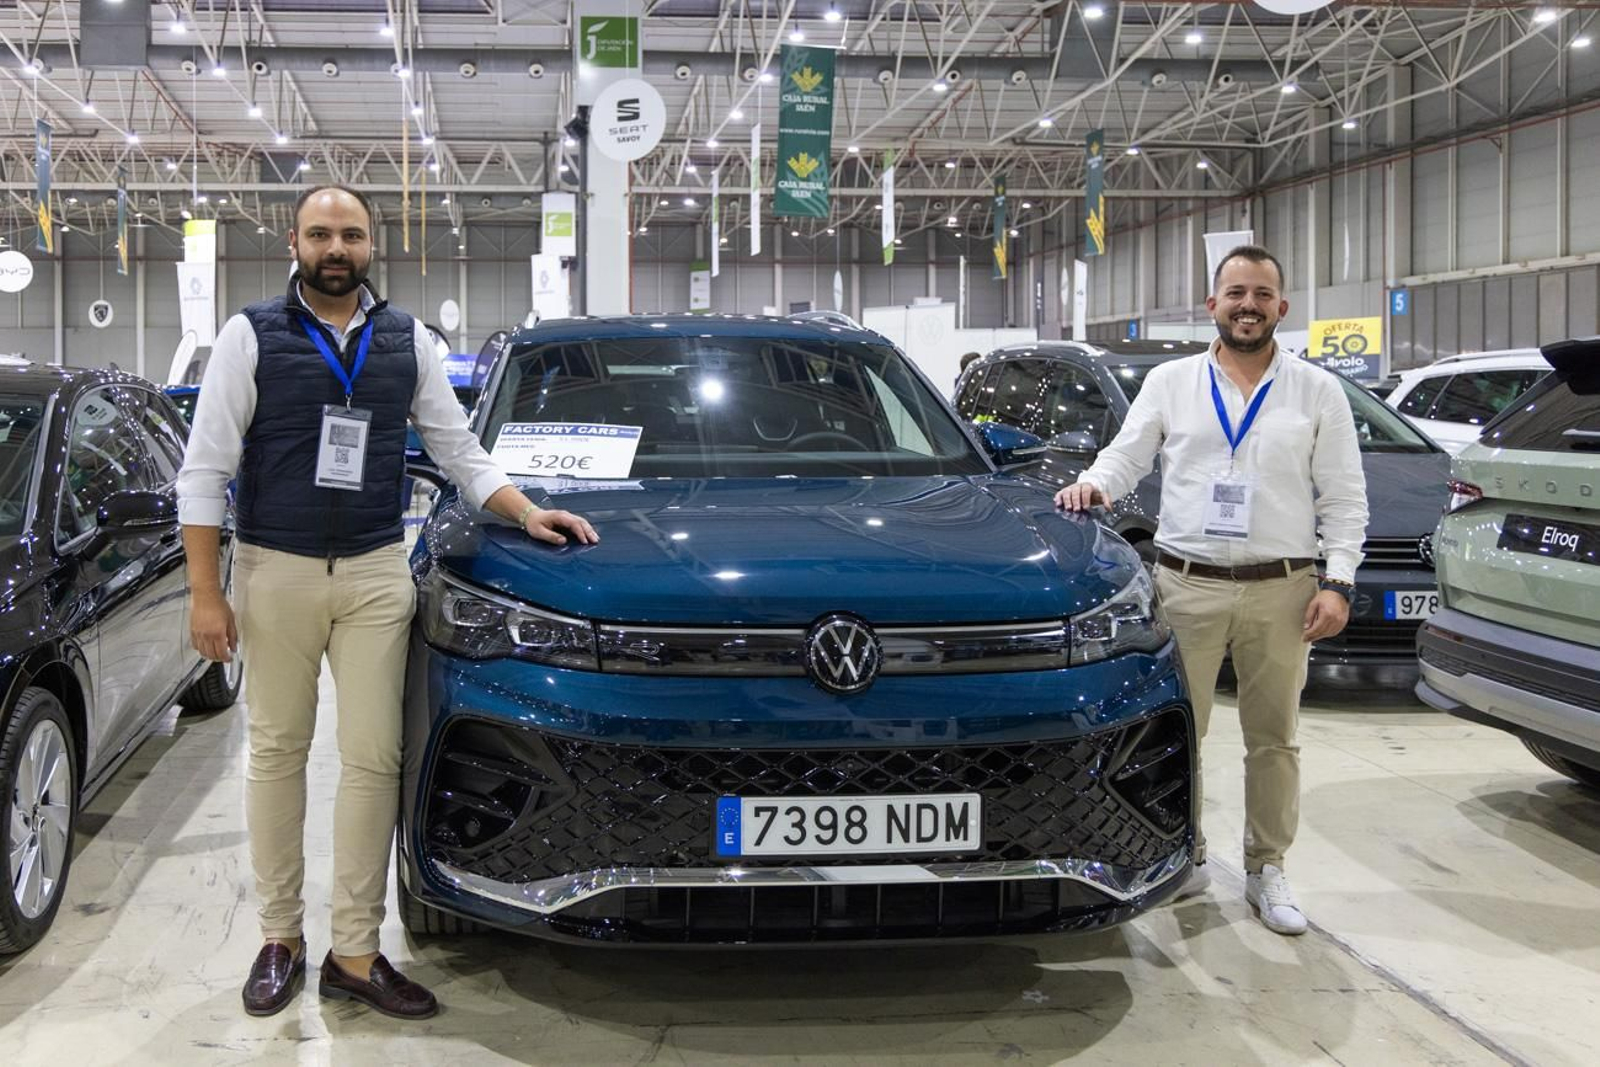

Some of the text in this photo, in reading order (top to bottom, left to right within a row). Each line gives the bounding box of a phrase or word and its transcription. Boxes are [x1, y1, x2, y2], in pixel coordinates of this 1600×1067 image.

[802, 95, 830, 105] RURAL
[608, 125, 648, 135] SEAT
[798, 181, 826, 190] RURAL
[1395, 293, 1405, 311] 5
[1323, 323, 1364, 336] OFERTA
[503, 425, 575, 434] FACTORY
[577, 426, 619, 436] CARS
[528, 454, 593, 470] 520€
[1541, 526, 1580, 552] Elroq
[1401, 595, 1439, 615] 978
[753, 802, 969, 847] 7398 NDM
[724, 833, 735, 844] E
